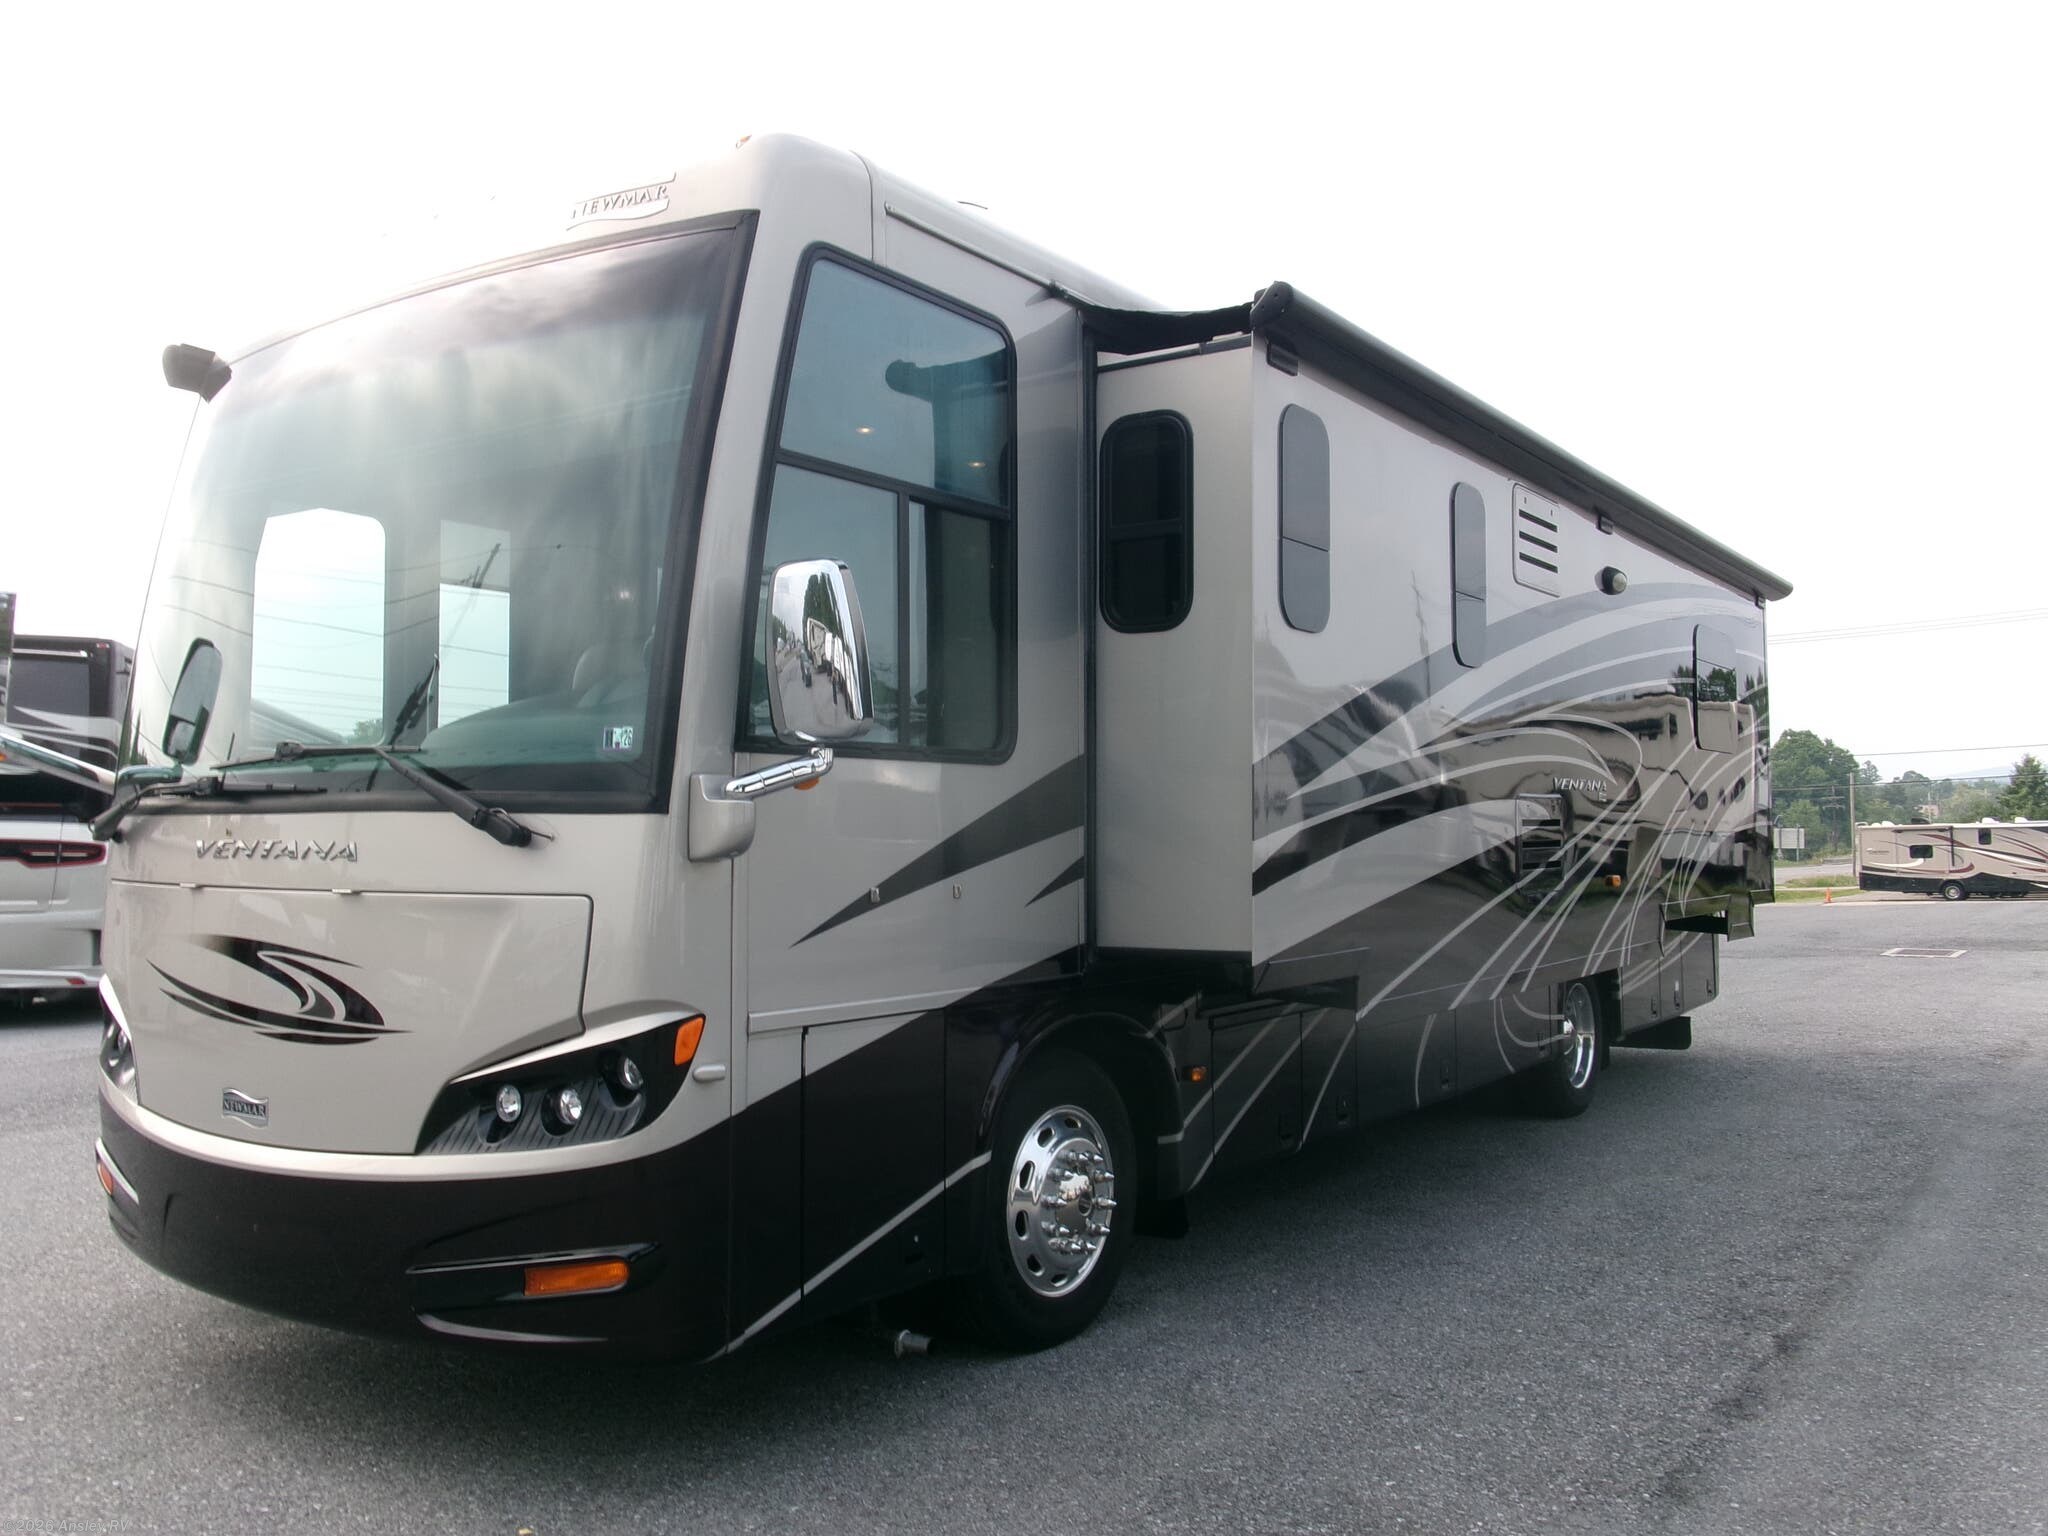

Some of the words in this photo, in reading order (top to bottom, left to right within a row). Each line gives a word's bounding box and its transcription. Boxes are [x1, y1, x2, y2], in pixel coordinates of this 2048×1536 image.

[1552, 777, 1607, 792] VENTANA
[195, 839, 358, 862] VENTANA
[223, 1099, 266, 1117] NEWMAR
